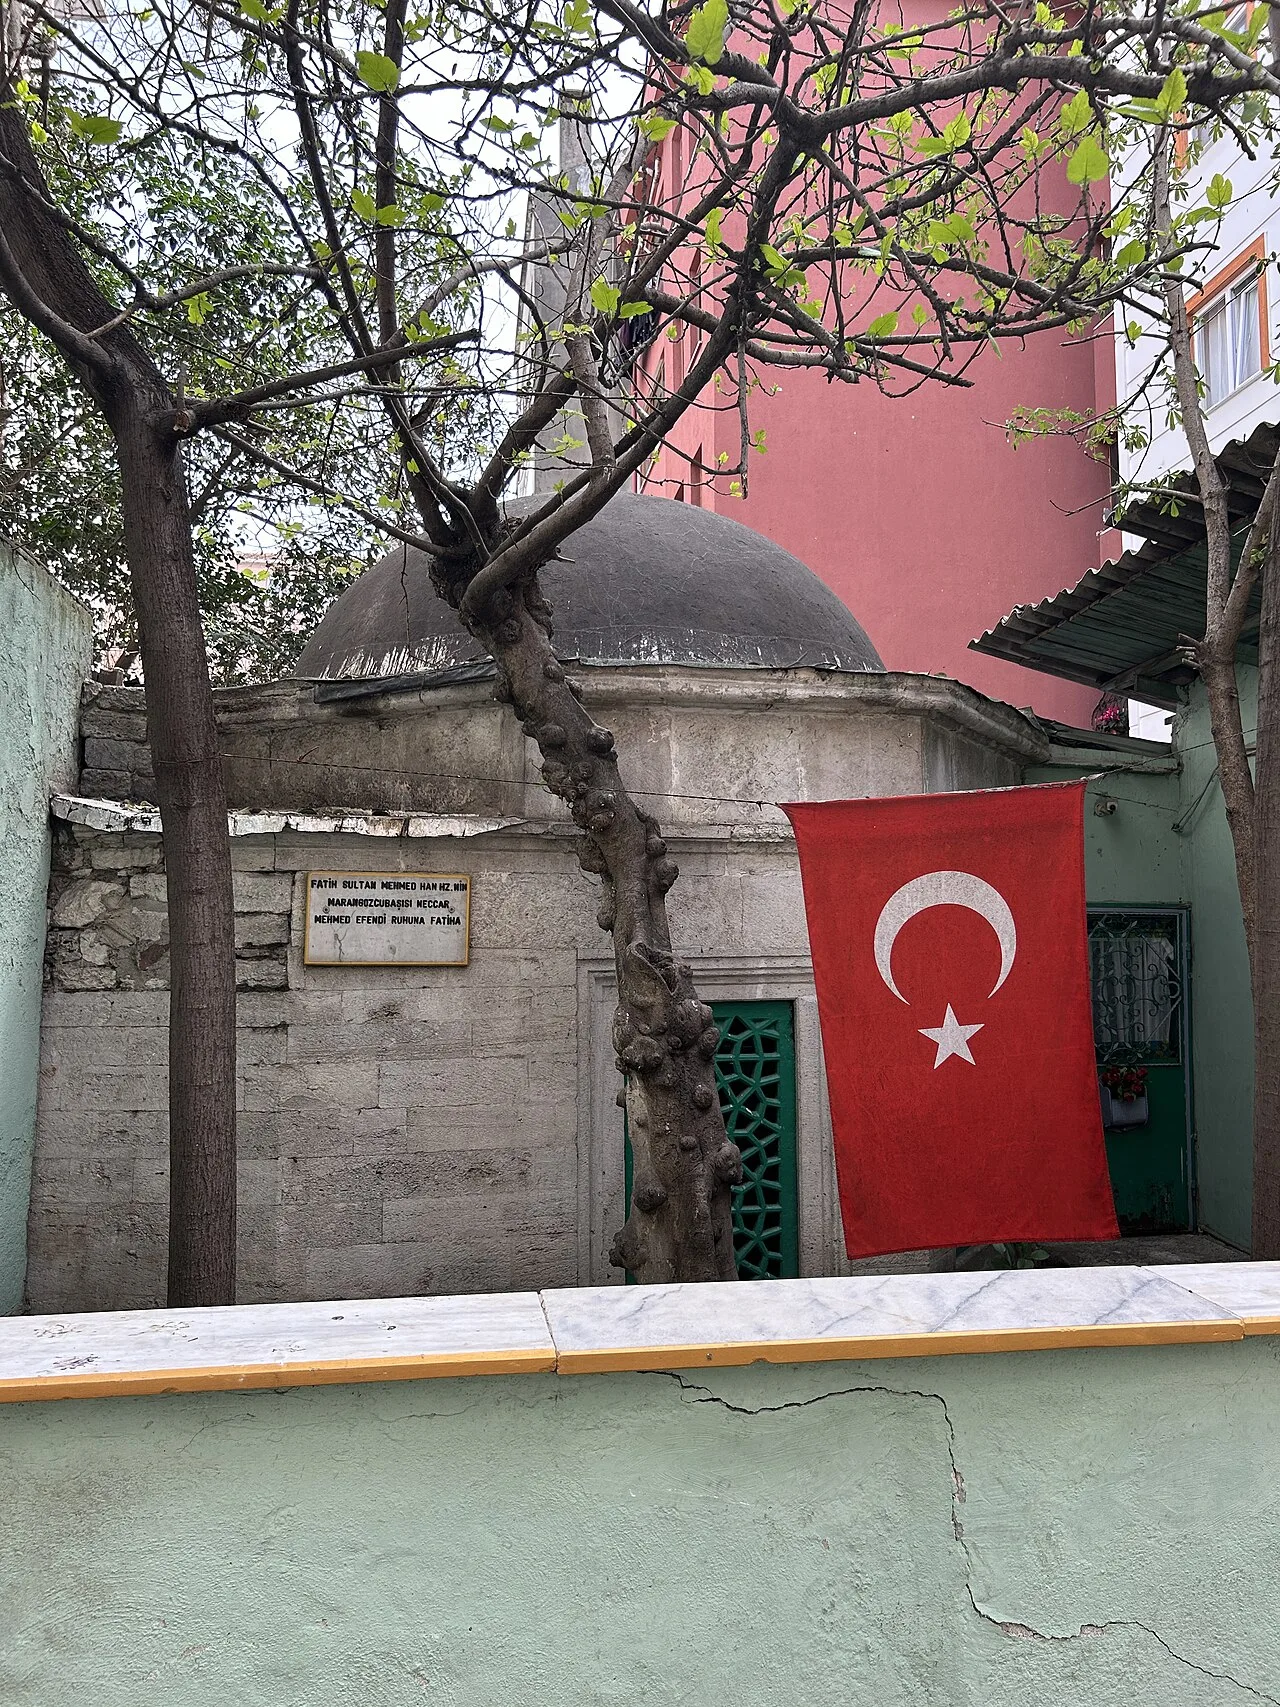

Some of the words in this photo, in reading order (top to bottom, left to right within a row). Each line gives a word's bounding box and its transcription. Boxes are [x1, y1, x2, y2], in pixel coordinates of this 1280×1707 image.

[310, 878, 338, 889] FATİH
[342, 880, 376, 890] SULTAN
[381, 881, 417, 891] MEHMED
[420, 882, 437, 891] HAN
[327, 898, 413, 911] MARANGOZCUBAŞISI
[416, 900, 450, 909] NECCAR
[314, 915, 351, 924] MEHMED
[355, 913, 387, 925] EFENDİ
[391, 915, 425, 925] RUHUNA
[430, 914, 461, 926] FATİHA
